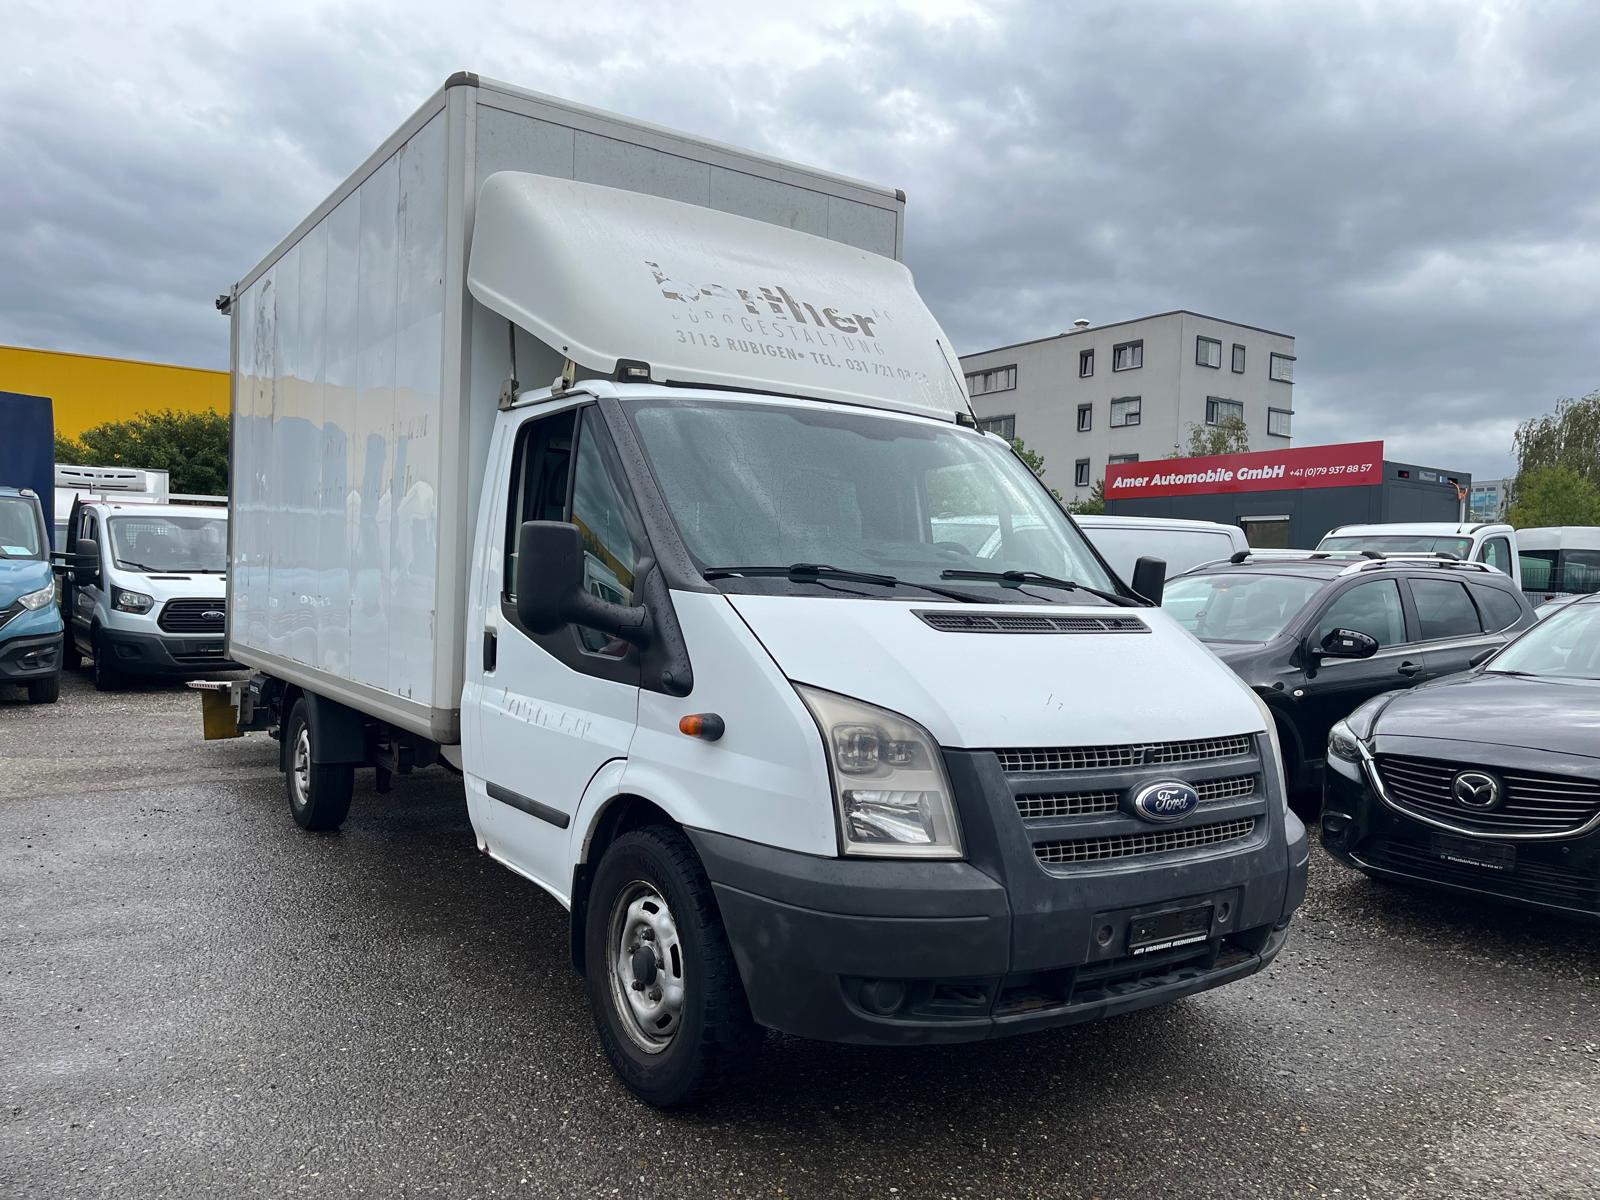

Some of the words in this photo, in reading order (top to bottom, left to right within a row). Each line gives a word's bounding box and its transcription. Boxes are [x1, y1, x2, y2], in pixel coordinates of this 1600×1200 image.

[677, 329, 720, 349] 3113
[727, 337, 797, 361] RUBIGEN
[810, 351, 842, 369] TEL.
[845, 358, 869, 374] 031
[1112, 475, 1149, 489] Amer
[1150, 467, 1234, 487] Automobile
[1236, 464, 1285, 482] GmbH
[1289, 468, 1304, 477] +41
[1304, 466, 1327, 478] (0)79
[1328, 465, 1346, 475] 937
[1346, 464, 1359, 473] 88
[1360, 463, 1373, 473] 57
[1155, 789, 1189, 812] Ford
